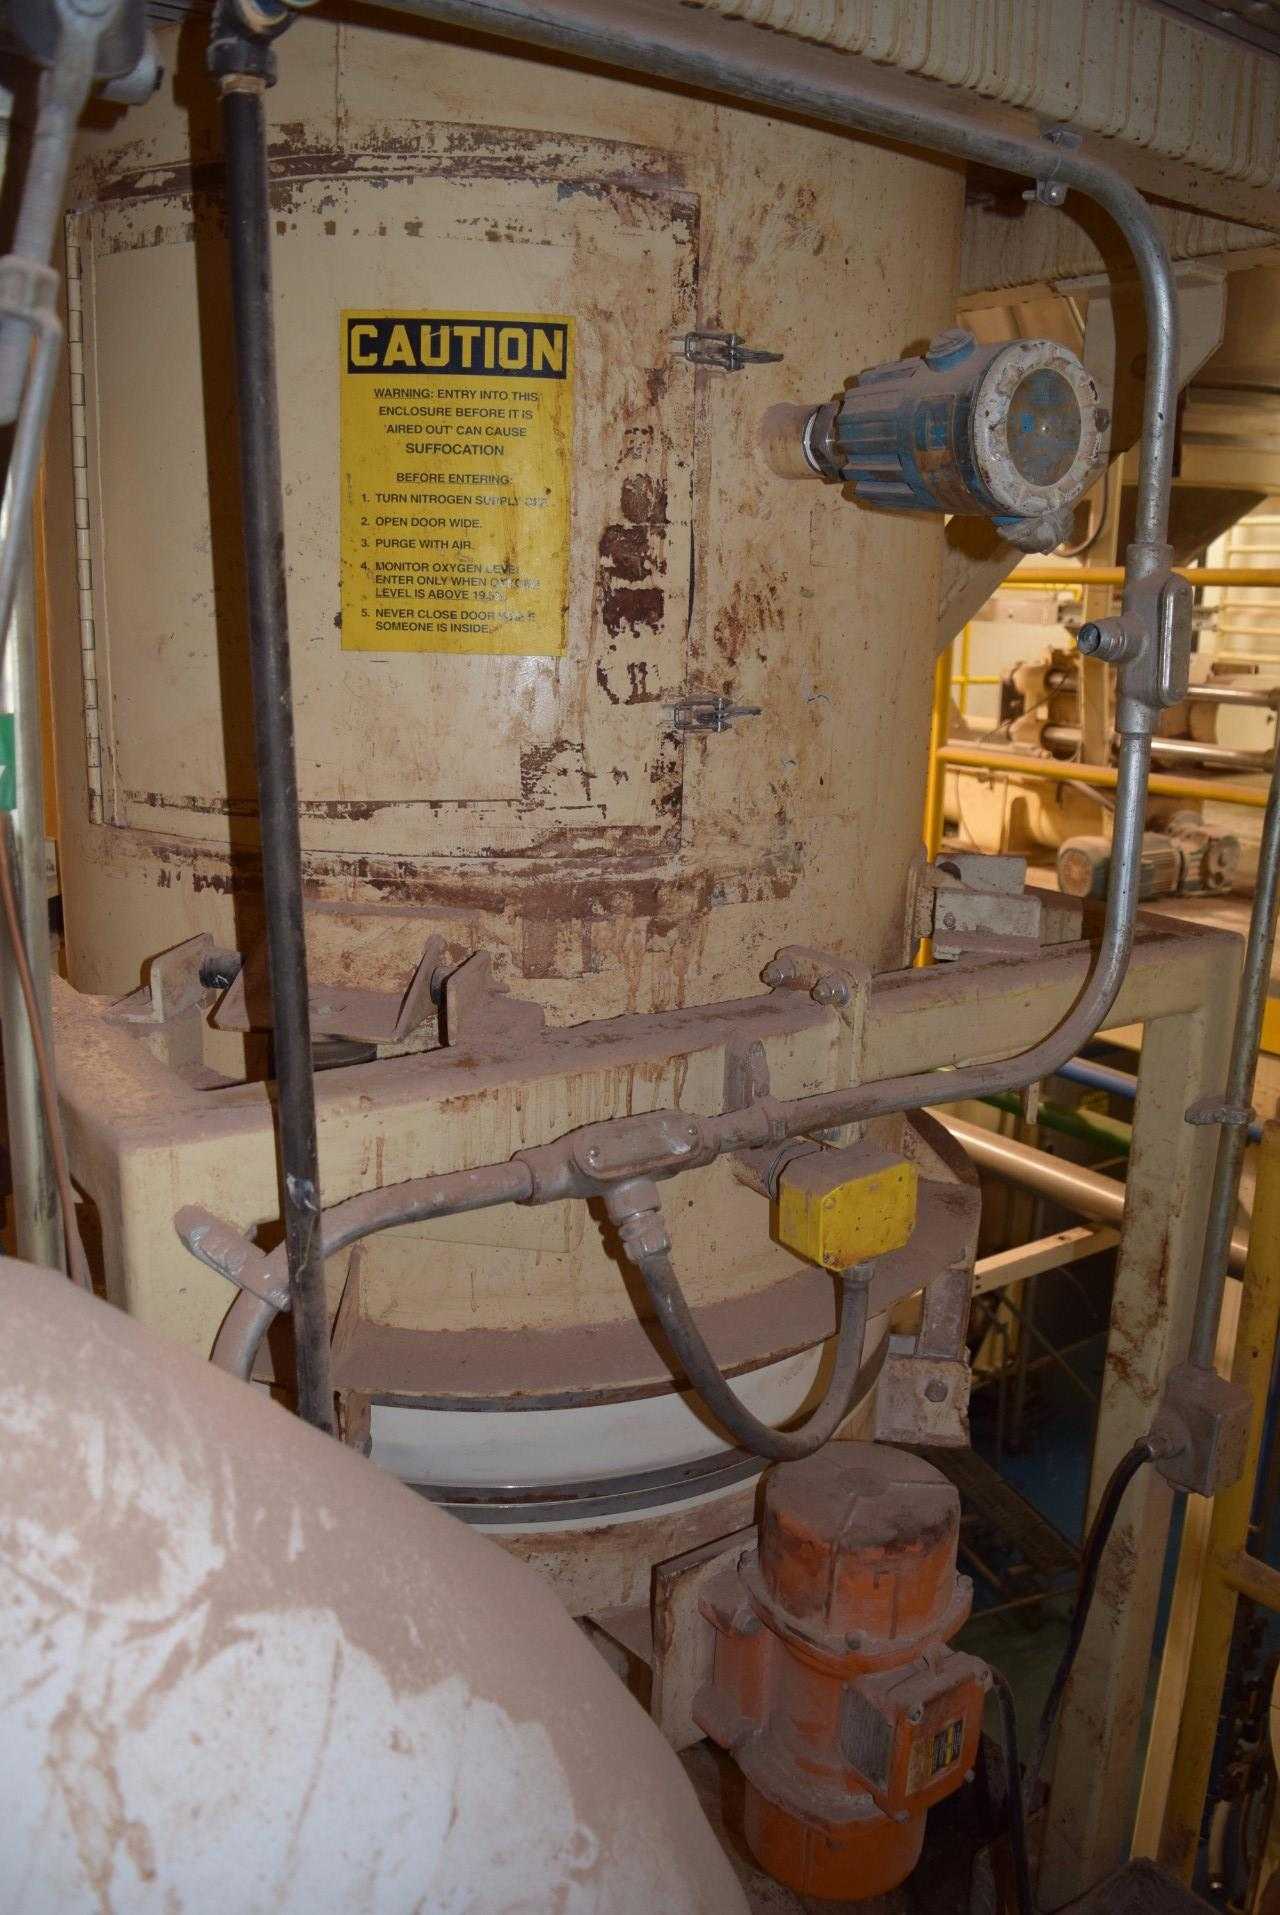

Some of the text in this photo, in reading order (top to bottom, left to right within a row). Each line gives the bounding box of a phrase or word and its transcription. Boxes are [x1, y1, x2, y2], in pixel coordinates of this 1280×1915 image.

[351, 324, 563, 371] CAUTION
[374, 388, 538, 402] WARNING: ENTRY INTO THIS
[379, 406, 533, 419] ENCLOSURE BEFORE IT IS
[456, 426, 481, 436] CAN
[485, 427, 527, 437] CAUSE
[406, 443, 504, 456] SUFFOCATION
[396, 472, 513, 485] BEFORE ENTERING:
[361, 493, 369, 502] 1.
[376, 493, 407, 504] TURN
[410, 494, 472, 505] NITROGEN
[361, 517, 369, 526] 2.
[376, 517, 407, 526] OPEN
[411, 518, 445, 527] DOOR
[361, 539, 369, 547] 3.
[376, 539, 416, 549] PURGE
[419, 540, 448, 549] WITH
[360, 562, 521, 574] 4. MONITOR OXYGEN LEVE
[376, 575, 413, 585] ENTER
[417, 576, 447, 585] ONLY
[451, 577, 486, 587] WHEN
[376, 588, 411, 598] LEVEL
[415, 589, 425, 599] IS
[428, 589, 468, 600] ABOVE
[361, 609, 369, 617] 5.
[376, 609, 414, 618] NEVER
[418, 610, 457, 619] CLOSE
[461, 611, 496, 620] DOOR
[376, 621, 433, 632] SOMEONE
[437, 623, 447, 632] IS
